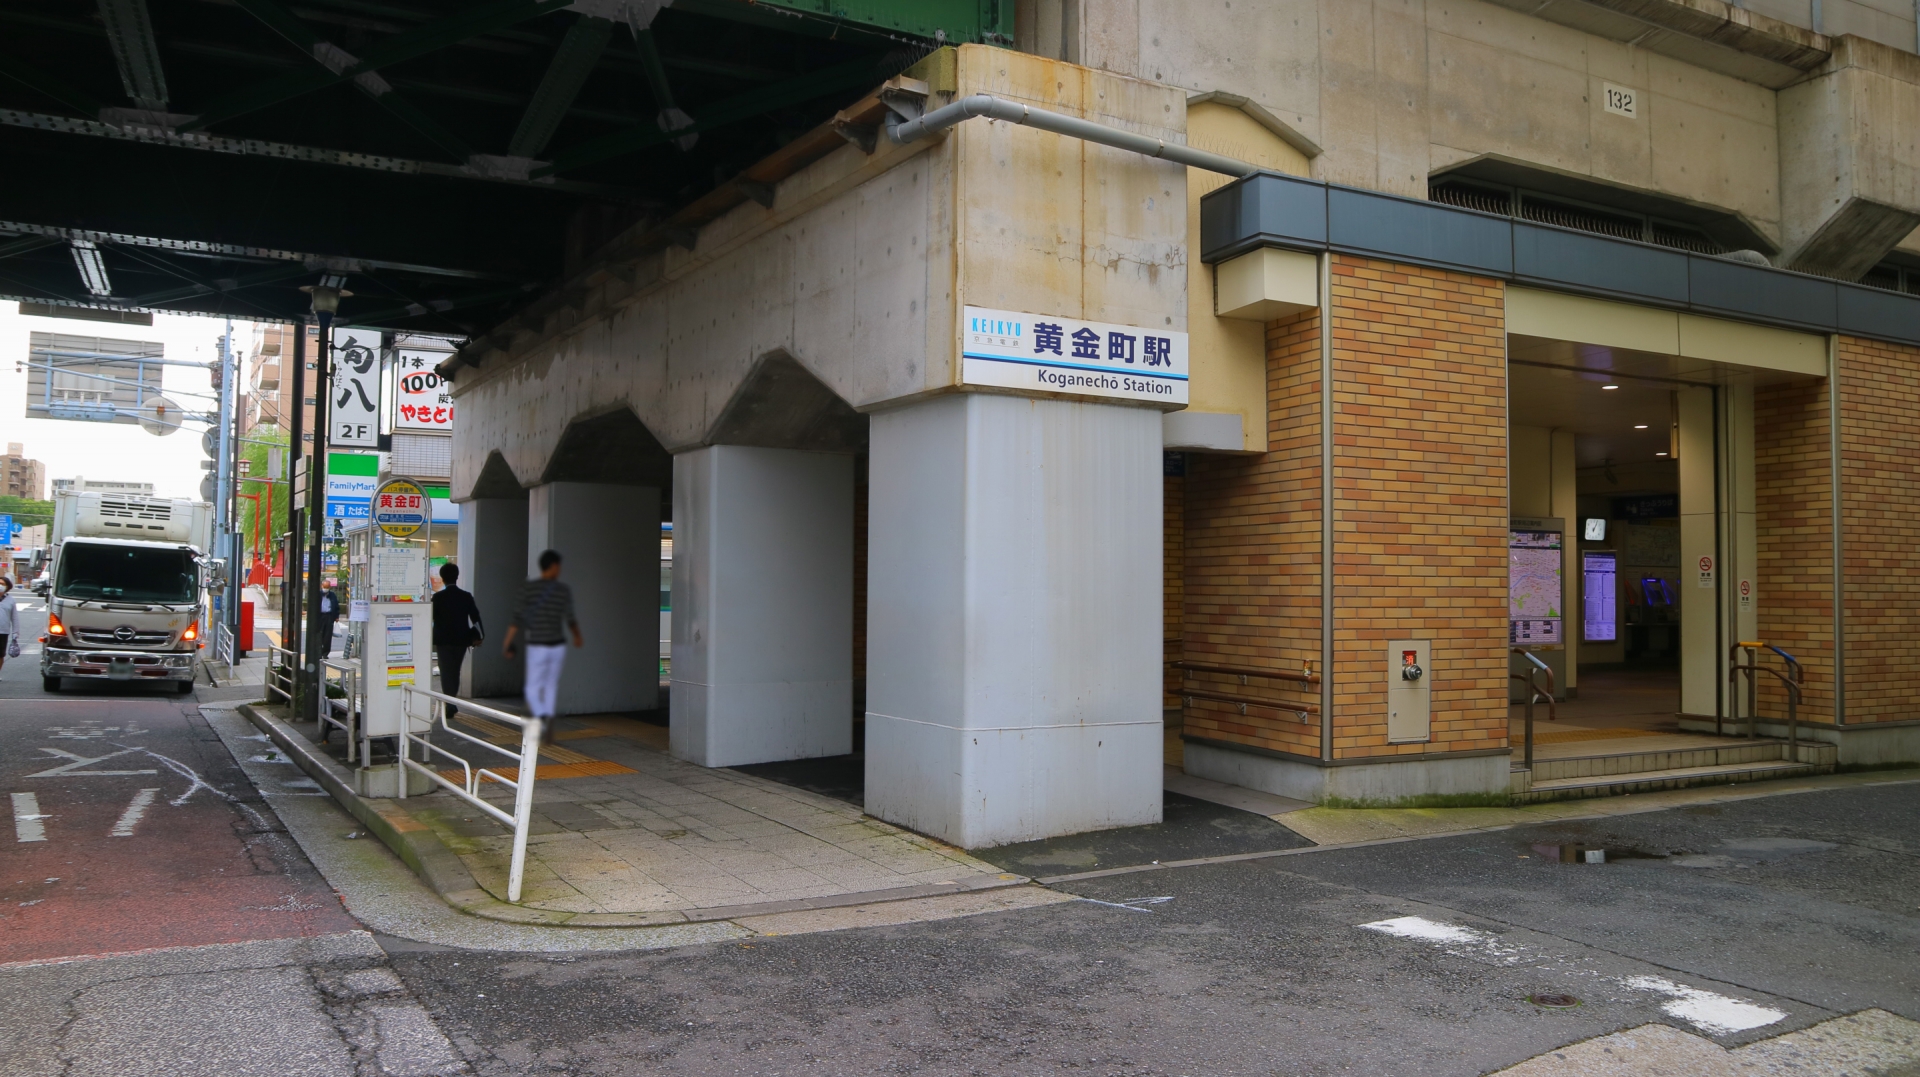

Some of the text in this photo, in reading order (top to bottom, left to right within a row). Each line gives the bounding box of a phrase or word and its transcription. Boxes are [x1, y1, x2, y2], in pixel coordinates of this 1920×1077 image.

[1607, 89, 1632, 113] 132
[971, 317, 1021, 337] KEIKYU
[1033, 322, 1172, 368] 黄金町駅
[1038, 368, 1173, 395] Koganechō Station
[438, 393, 454, 404] 炭
[341, 424, 368, 439] 2F
[329, 482, 376, 492] FamilyMart
[379, 493, 422, 509] 黄金町
[334, 504, 345, 516] 酒
